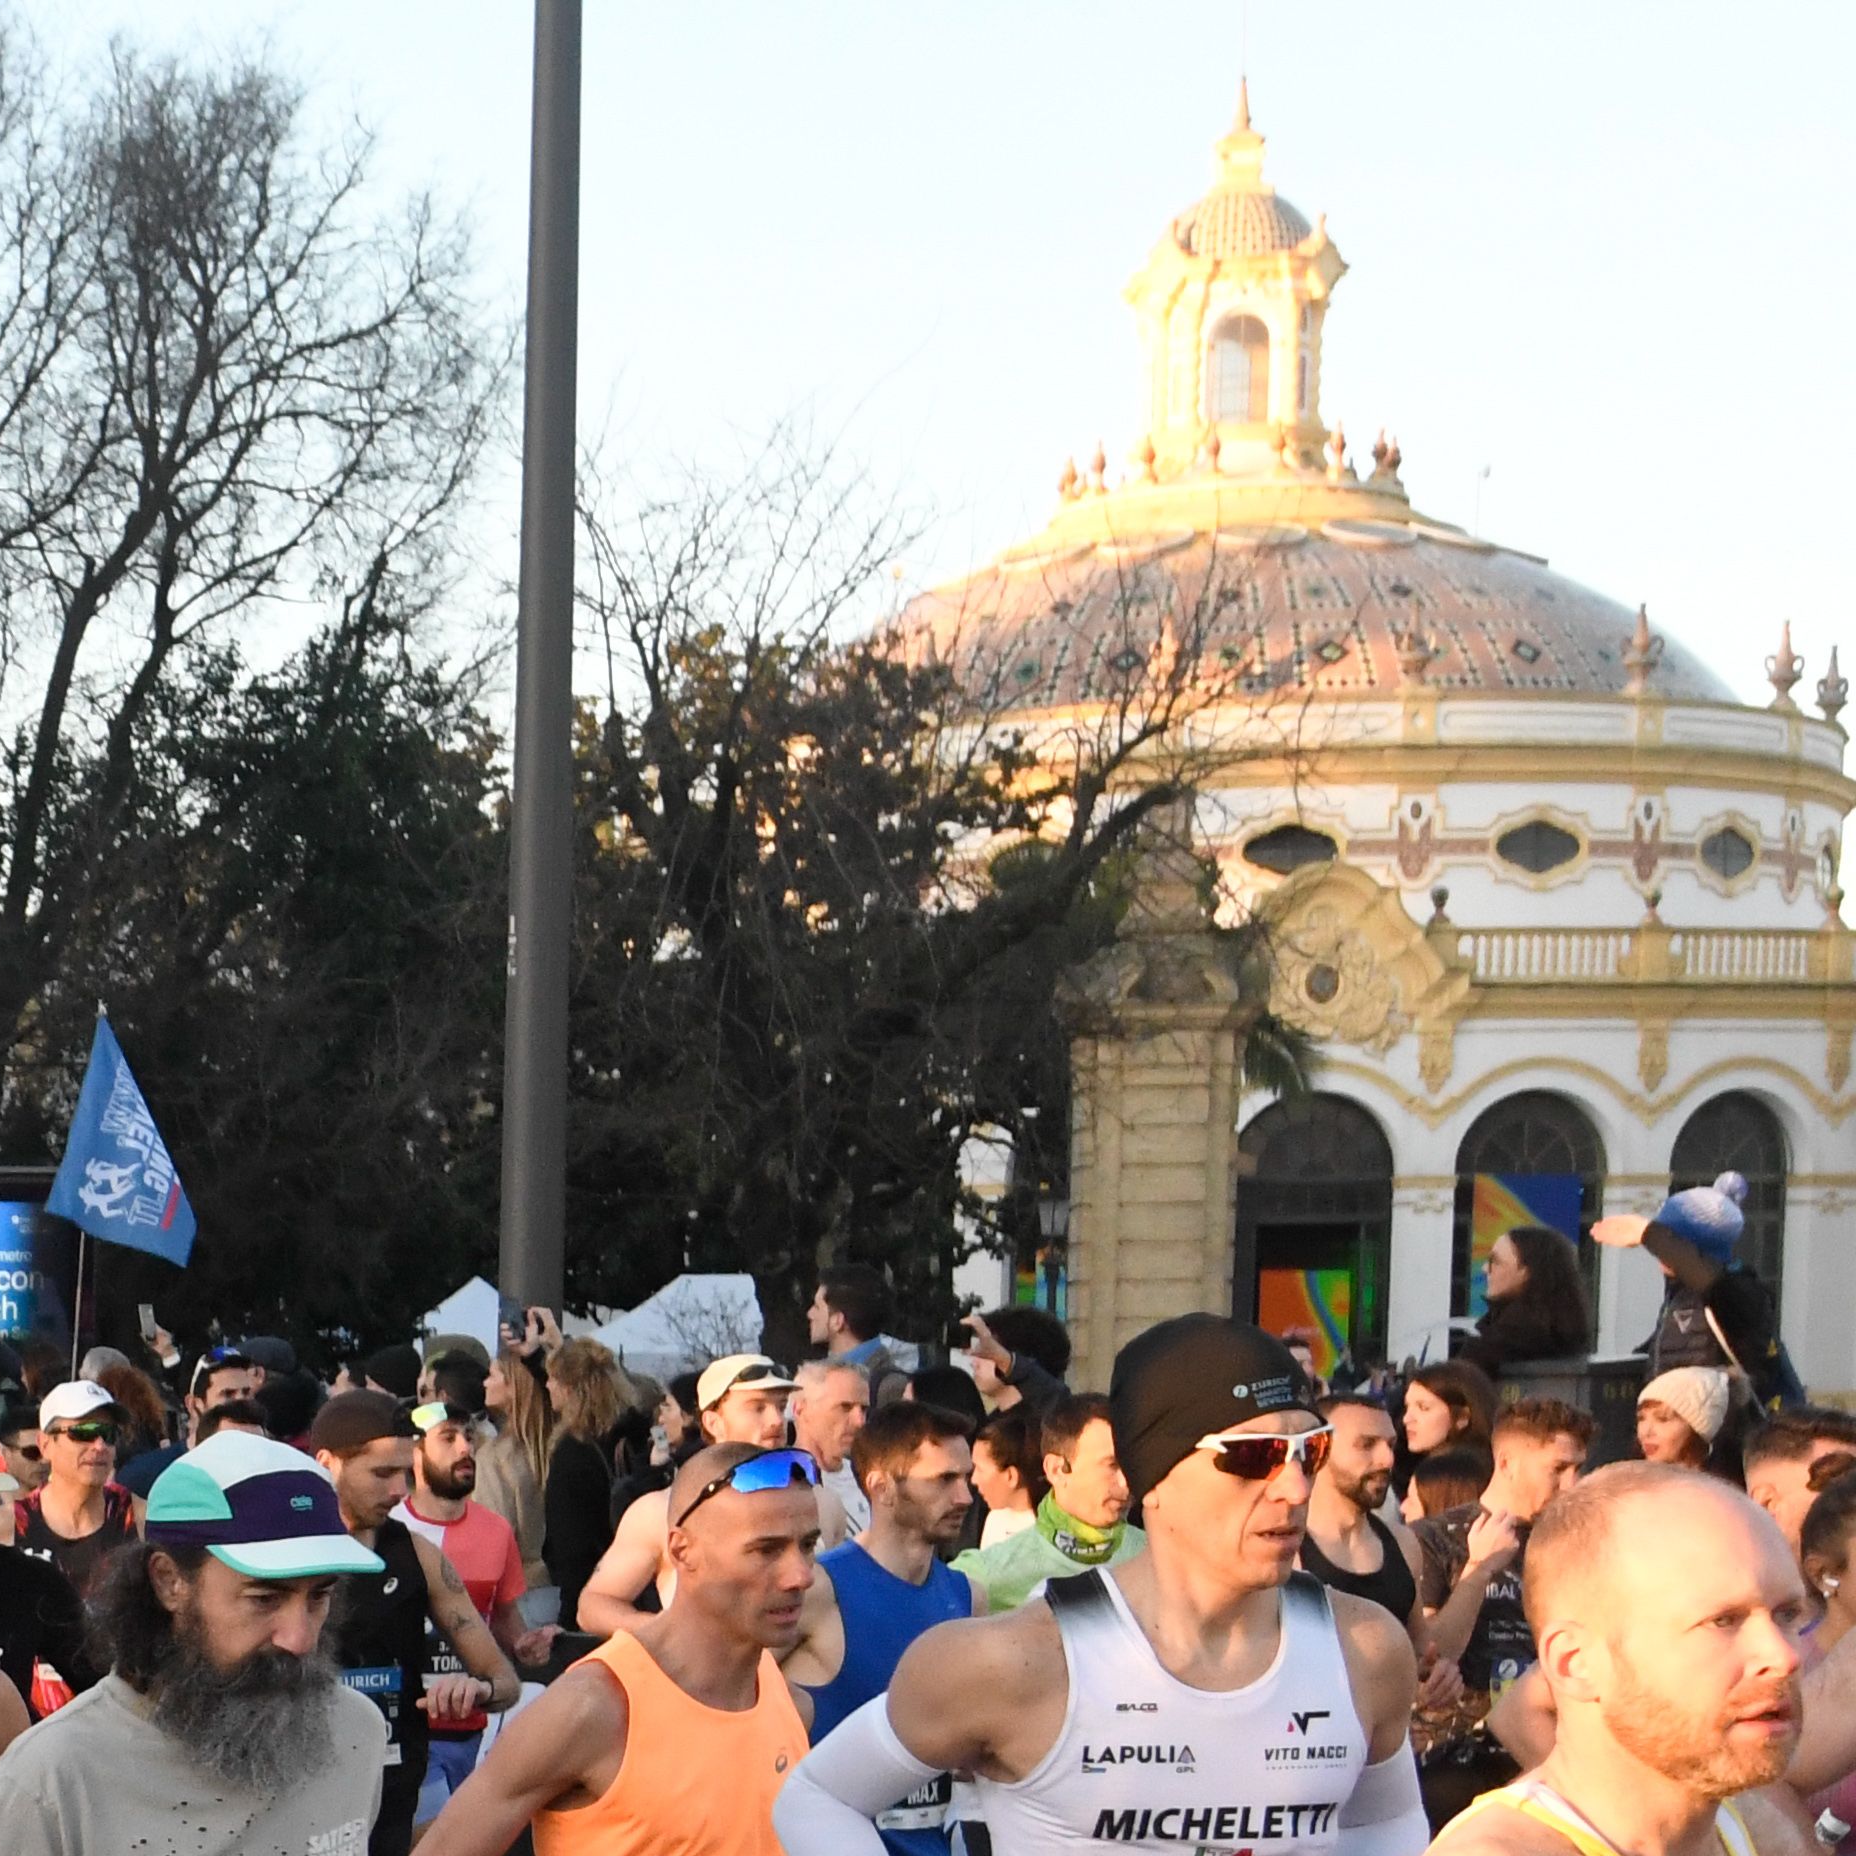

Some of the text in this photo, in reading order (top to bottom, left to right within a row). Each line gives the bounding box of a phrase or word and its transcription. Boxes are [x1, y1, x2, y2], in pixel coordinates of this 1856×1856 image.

[1485, 1581, 1516, 1600] IBAL
[340, 1673, 390, 1688] URICH
[1081, 1745, 1196, 1765] LAPULIA
[1264, 1745, 1348, 1761] VITO NACCI
[1091, 1802, 1339, 1842] MICHELETTI
